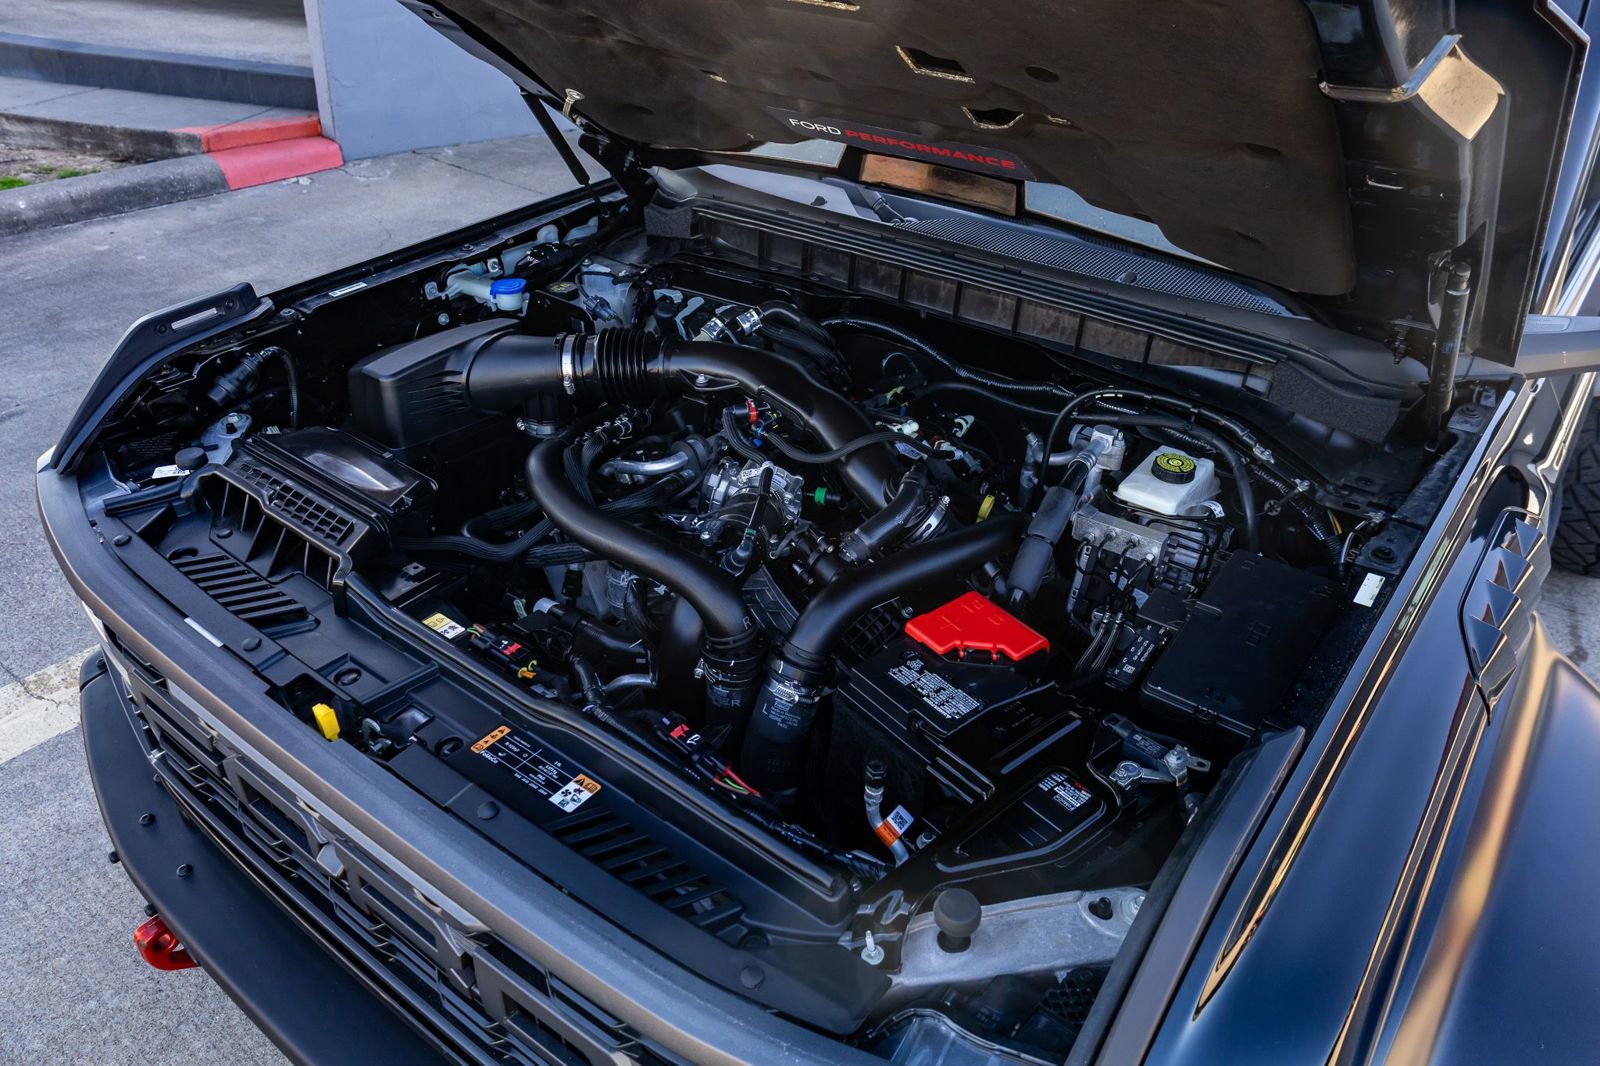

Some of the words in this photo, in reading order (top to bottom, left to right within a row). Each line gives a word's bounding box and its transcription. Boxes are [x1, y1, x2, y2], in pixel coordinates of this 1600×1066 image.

[789, 118, 841, 135] FORD
[844, 128, 1018, 169] PERFORMANCE
[742, 616, 752, 630] R
